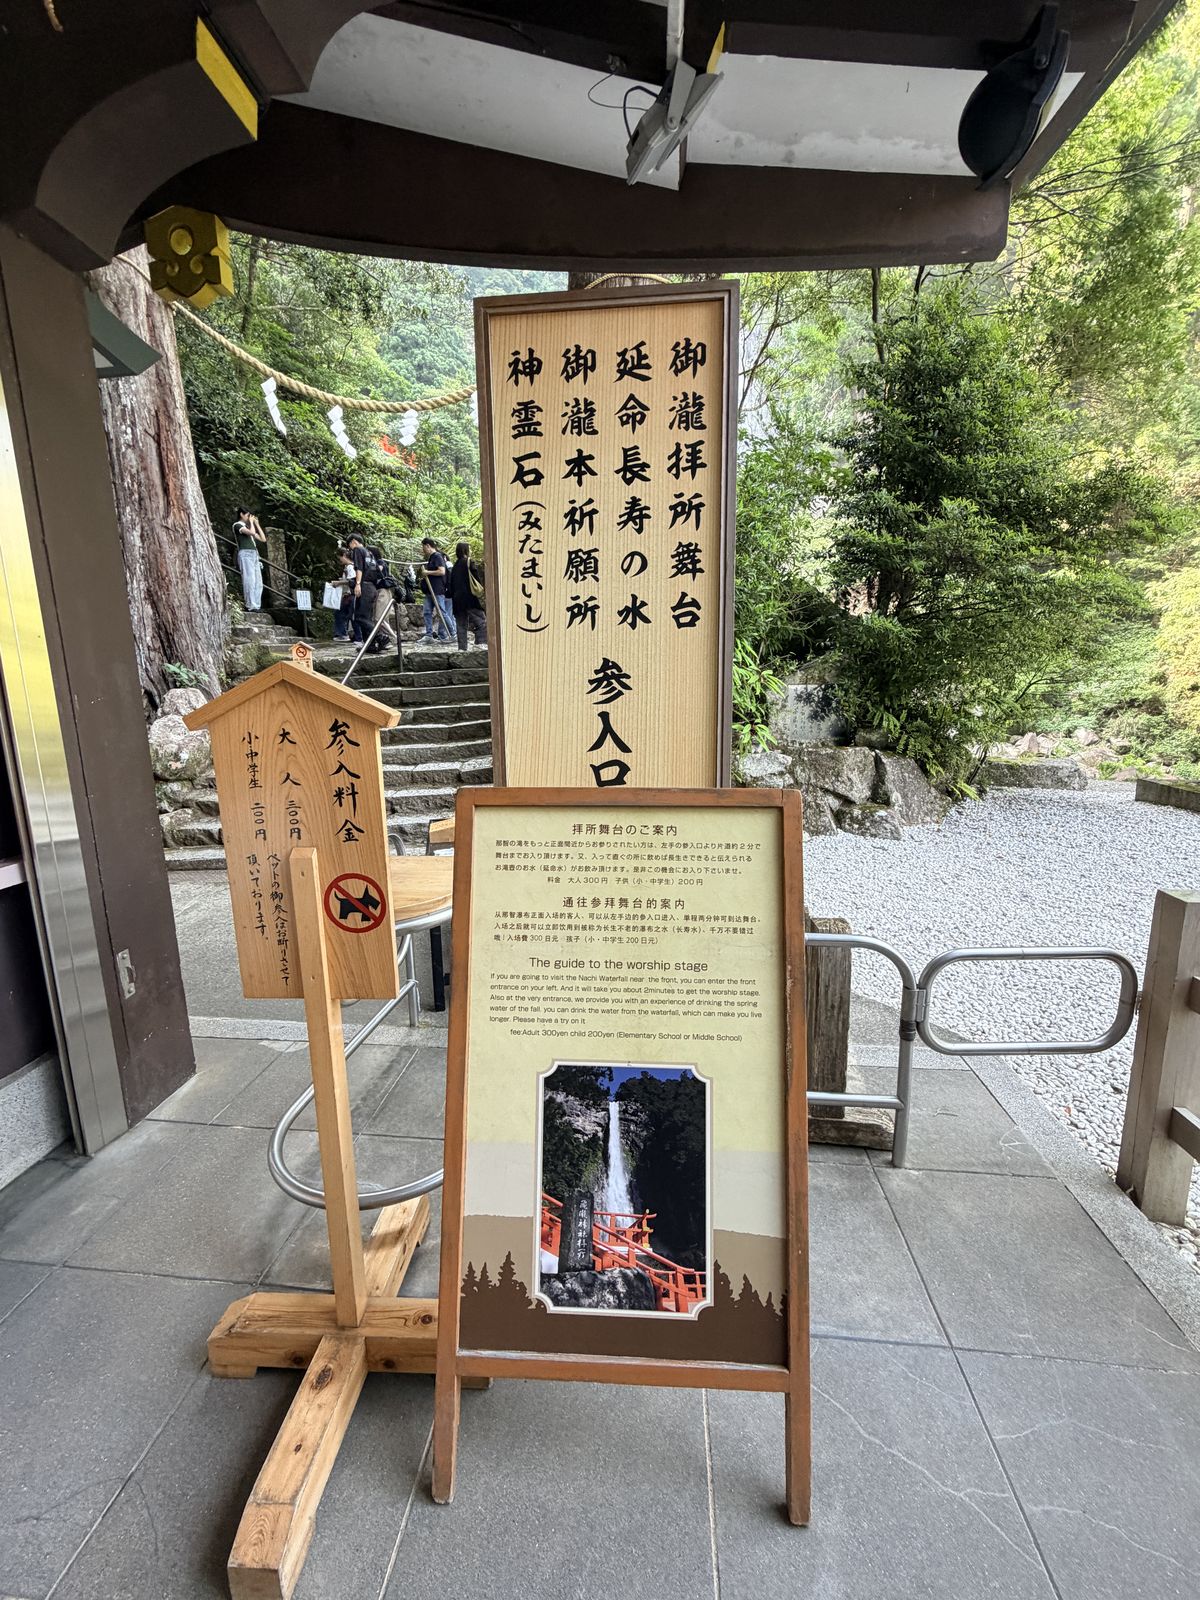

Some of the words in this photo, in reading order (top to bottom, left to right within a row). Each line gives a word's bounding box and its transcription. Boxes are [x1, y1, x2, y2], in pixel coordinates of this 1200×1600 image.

[612, 339, 653, 632] 延命長寿の水
[586, 657, 633, 788] 参入口
[323, 718, 364, 843] 参入料金
[572, 824, 678, 836] 拝所舞台のご案内
[529, 957, 550, 968] The
[554, 958, 585, 969] guide
[589, 960, 601, 969] to
[604, 959, 623, 969] the
[627, 960, 671, 971] worship
[674, 961, 708, 972] stage
[740, 978, 756, 986] front
[712, 988, 738, 996] worship
[696, 999, 722, 1007] drinking
[736, 1000, 758, 1008] spring
[588, 1006, 599, 1014] the
[513, 1015, 535, 1023] Please
[537, 1016, 553, 1024] have
[560, 1017, 569, 1025] try
[542, 1029, 568, 1037] 300yen
[588, 1030, 614, 1038] 200yen
[616, 1031, 656, 1039] (Elementary
[658, 1032, 681, 1040] School
[692, 1033, 714, 1041] Middle
[716, 1034, 742, 1042] School)
